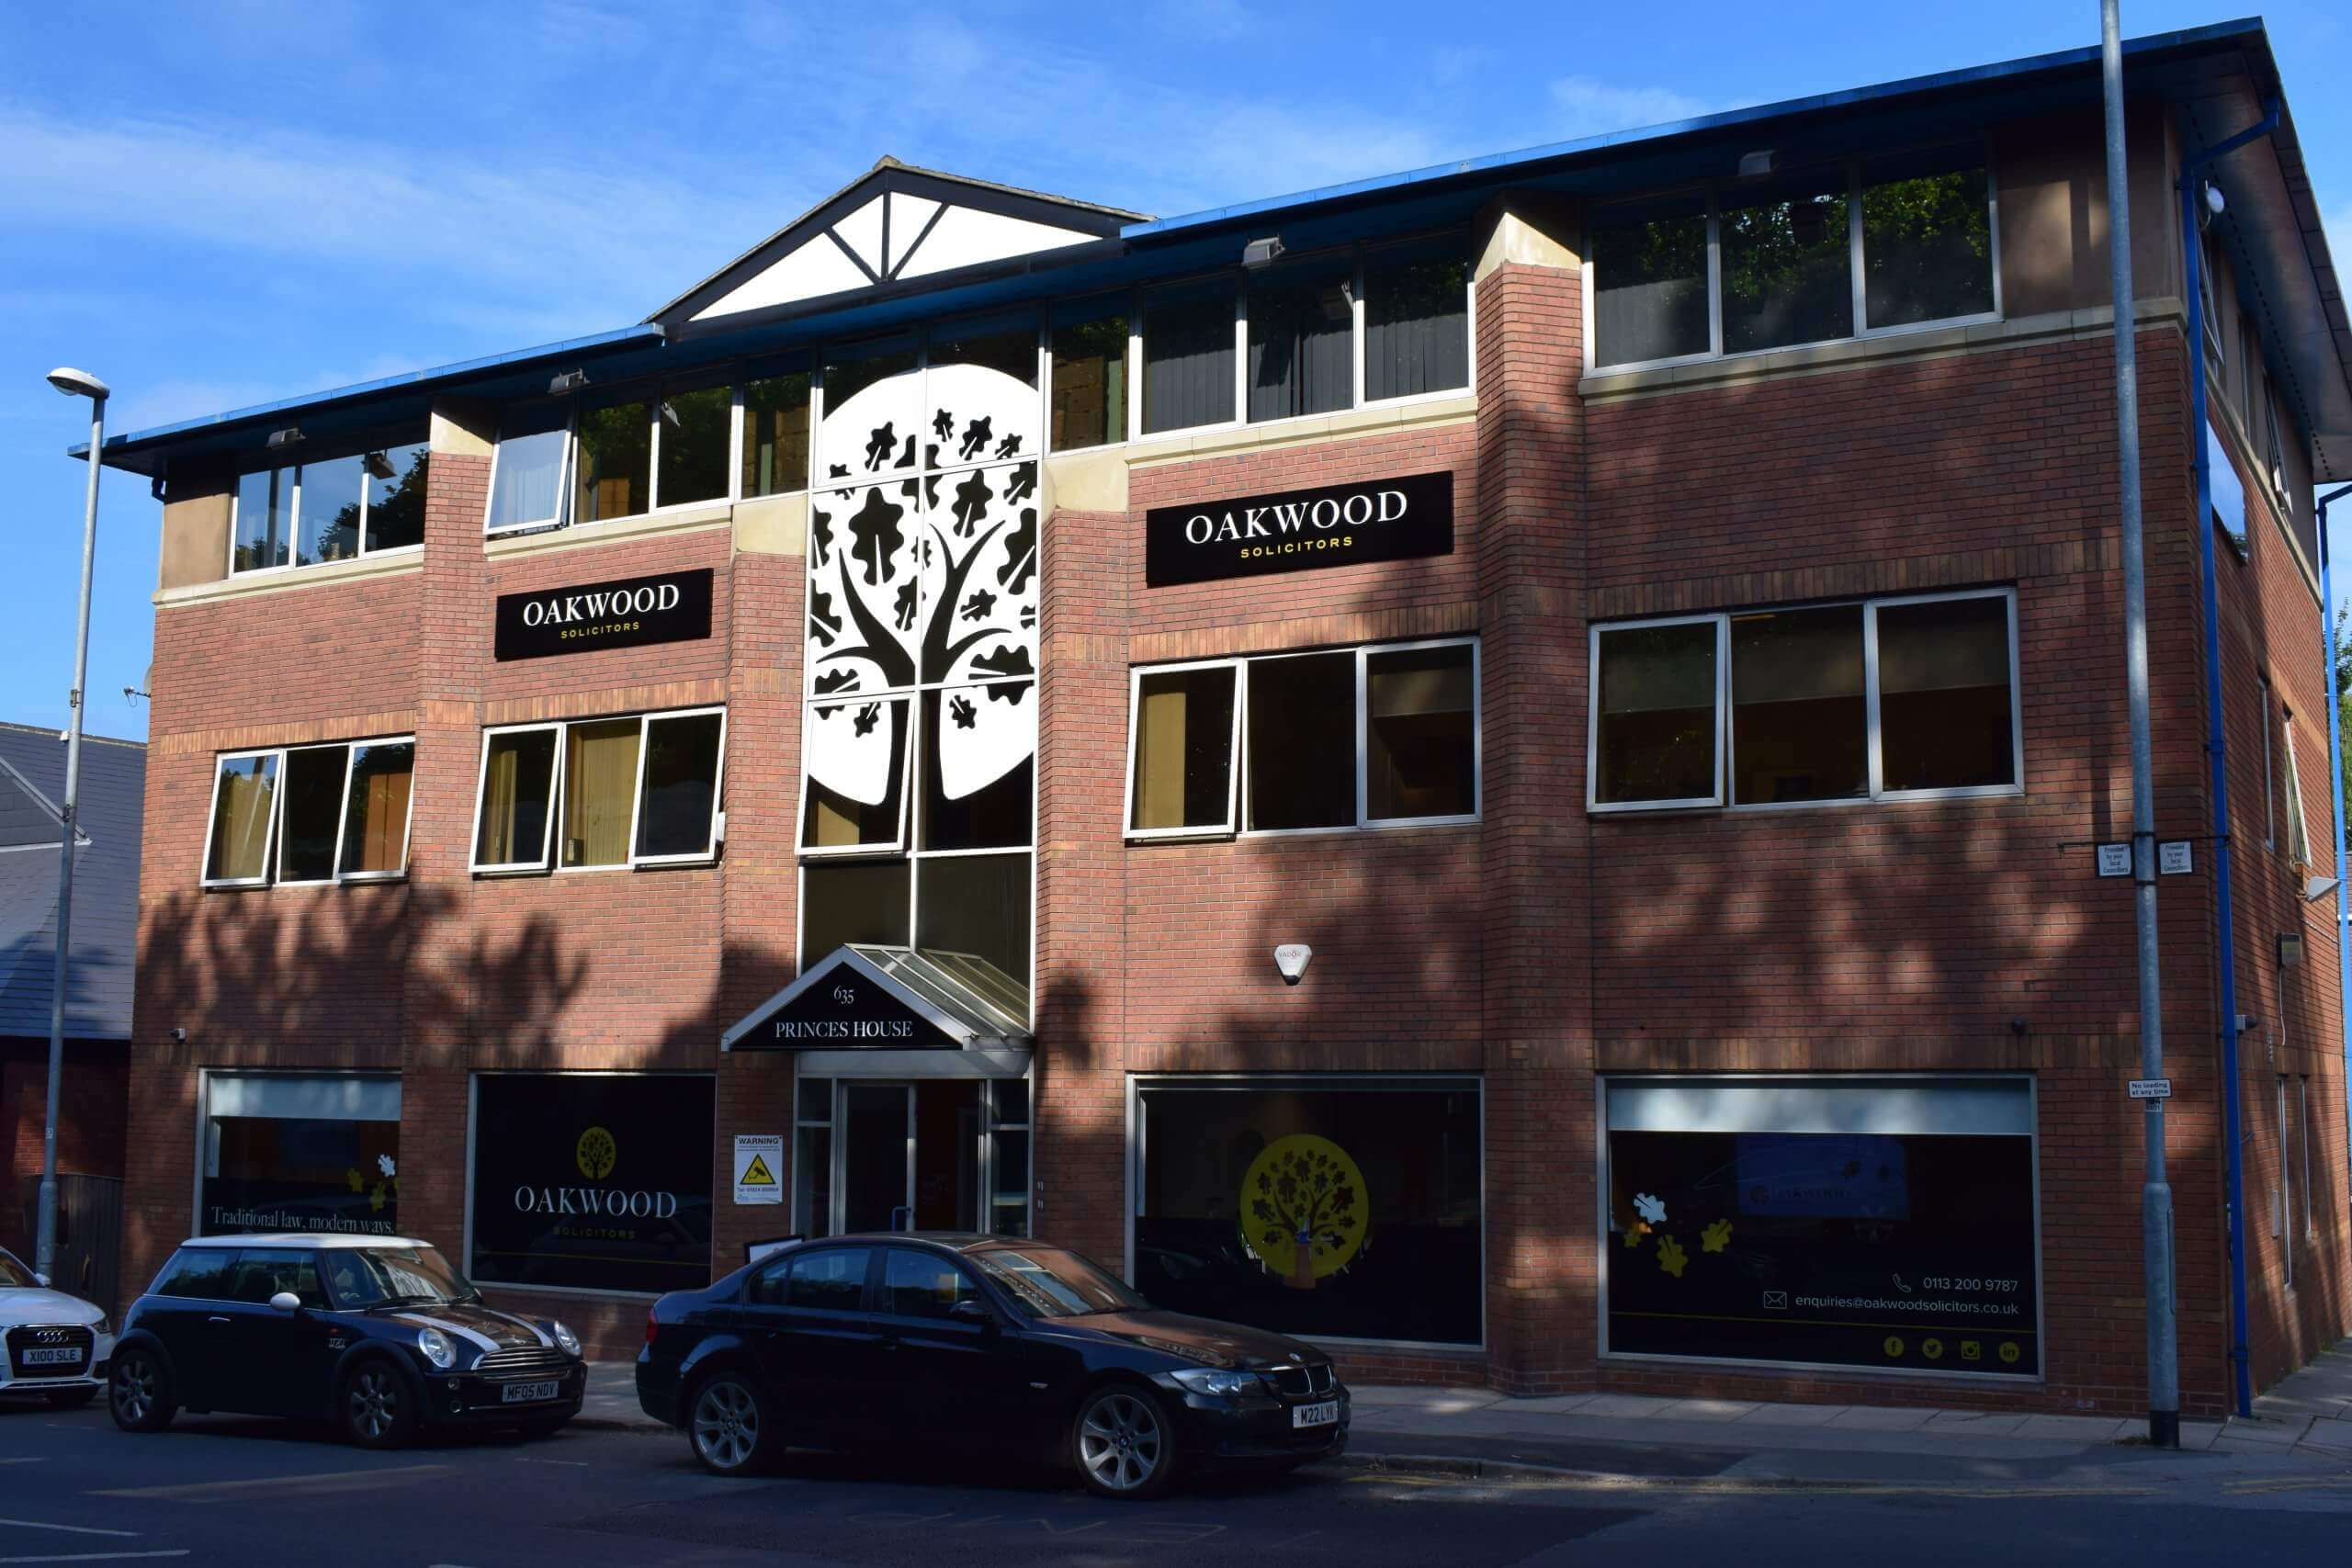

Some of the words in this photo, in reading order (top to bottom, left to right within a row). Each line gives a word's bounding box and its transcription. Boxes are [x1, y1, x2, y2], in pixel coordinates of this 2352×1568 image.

[1185, 491, 1408, 545] OAKWOOD
[1240, 536, 1352, 558] SOLICITORS
[523, 584, 680, 626] OAKWOOD
[560, 621, 640, 638] SOLICITORS
[833, 986, 854, 1005] 635
[775, 1021, 849, 1038] PRINCES
[854, 1021, 913, 1037] HOUSE
[514, 1186, 677, 1219] OAKWOOD
[211, 1206, 278, 1227] Traditional
[281, 1212, 306, 1230] law,
[309, 1214, 357, 1232] modern
[360, 1220, 395, 1235] ways.
[553, 1226, 636, 1239] SOLICITORS
[1923, 1277, 1951, 1290] 0113
[1954, 1278, 1982, 1291] 200
[1984, 1279, 2018, 1292] 9787
[1795, 1294, 2020, 1315] enquiries@oakwoodsolicitors.co.uk
[56, 1349, 75, 1360] SLE
[507, 1384, 535, 1399] MF05
[537, 1382, 555, 1397] NDV
[1300, 1406, 1319, 1426] M22
